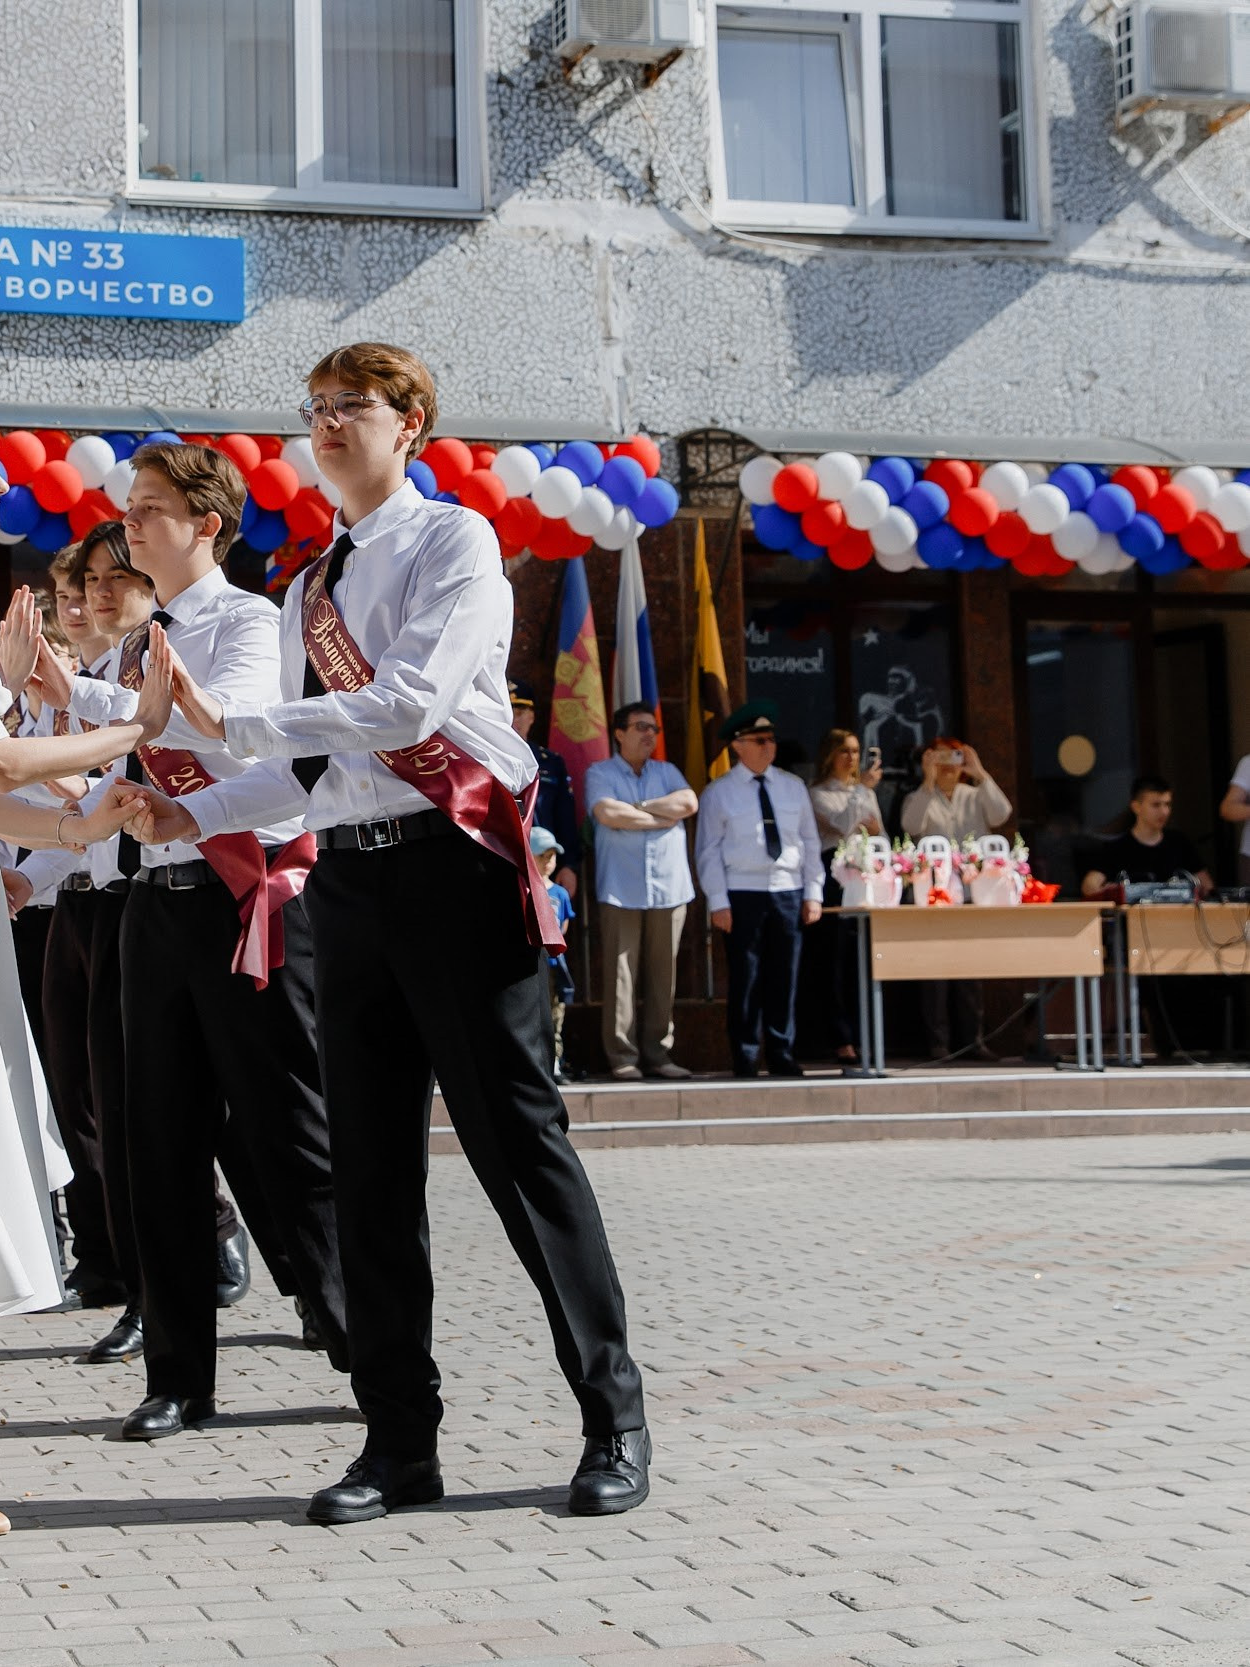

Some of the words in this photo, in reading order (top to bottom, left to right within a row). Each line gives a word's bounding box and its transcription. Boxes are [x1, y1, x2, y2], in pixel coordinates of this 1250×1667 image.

[31, 238, 72, 268] №
[82, 241, 126, 271] 33
[309, 598, 361, 693] Выпускн
[167, 766, 205, 795] 20
